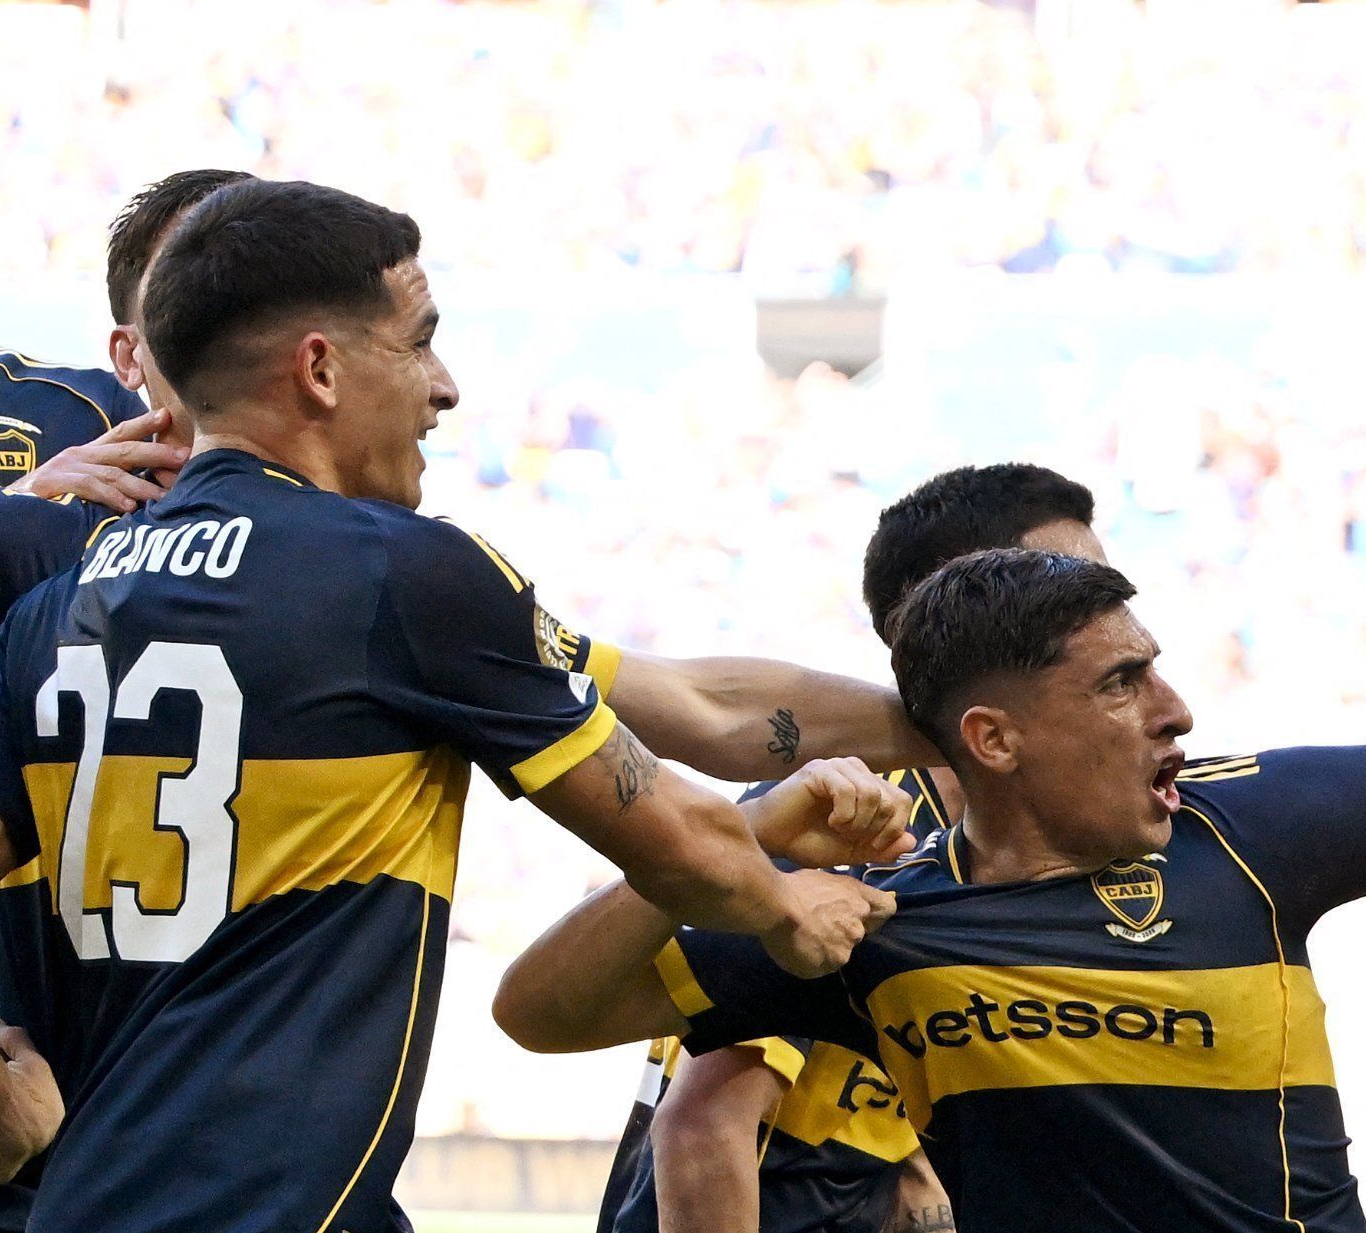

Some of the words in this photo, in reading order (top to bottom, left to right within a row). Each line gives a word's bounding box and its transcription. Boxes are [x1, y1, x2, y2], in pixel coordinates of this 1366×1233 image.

[78, 516, 253, 585] BLANCO
[35, 641, 244, 963] 23
[1105, 883, 1154, 898] CABJ
[883, 992, 1215, 1060] betsson
